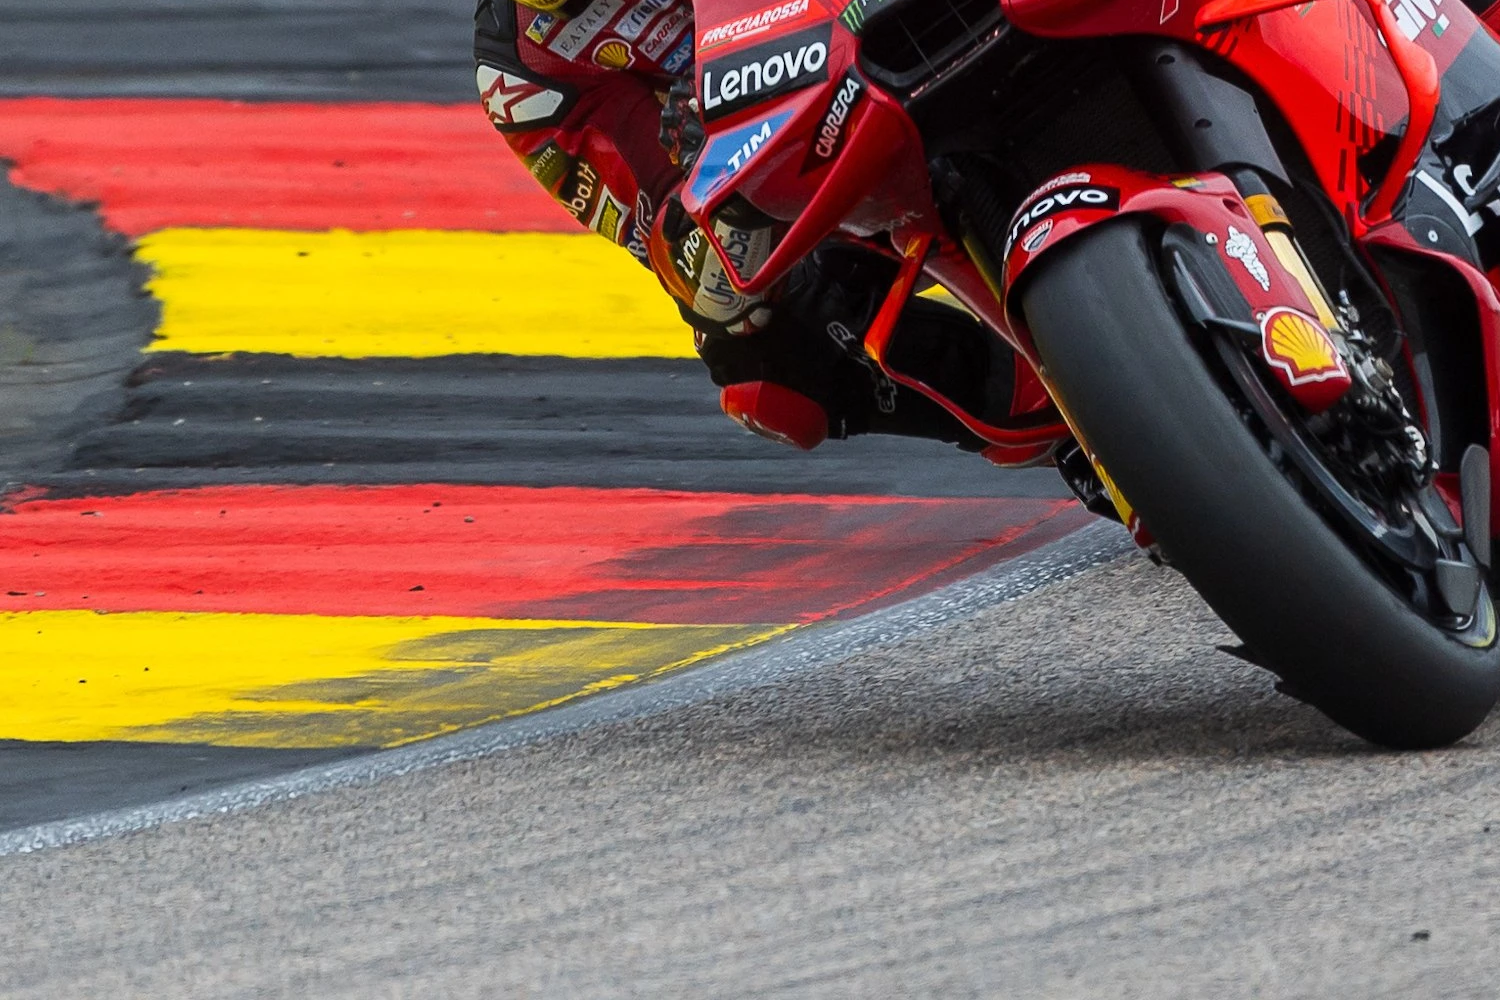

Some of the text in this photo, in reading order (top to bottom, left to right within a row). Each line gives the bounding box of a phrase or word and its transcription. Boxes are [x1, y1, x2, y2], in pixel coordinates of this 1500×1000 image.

[704, 42, 827, 110] Lenovo
[727, 122, 772, 171] TIM
[815, 78, 859, 158] CARRERA
[1004, 189, 1109, 261] enovo
